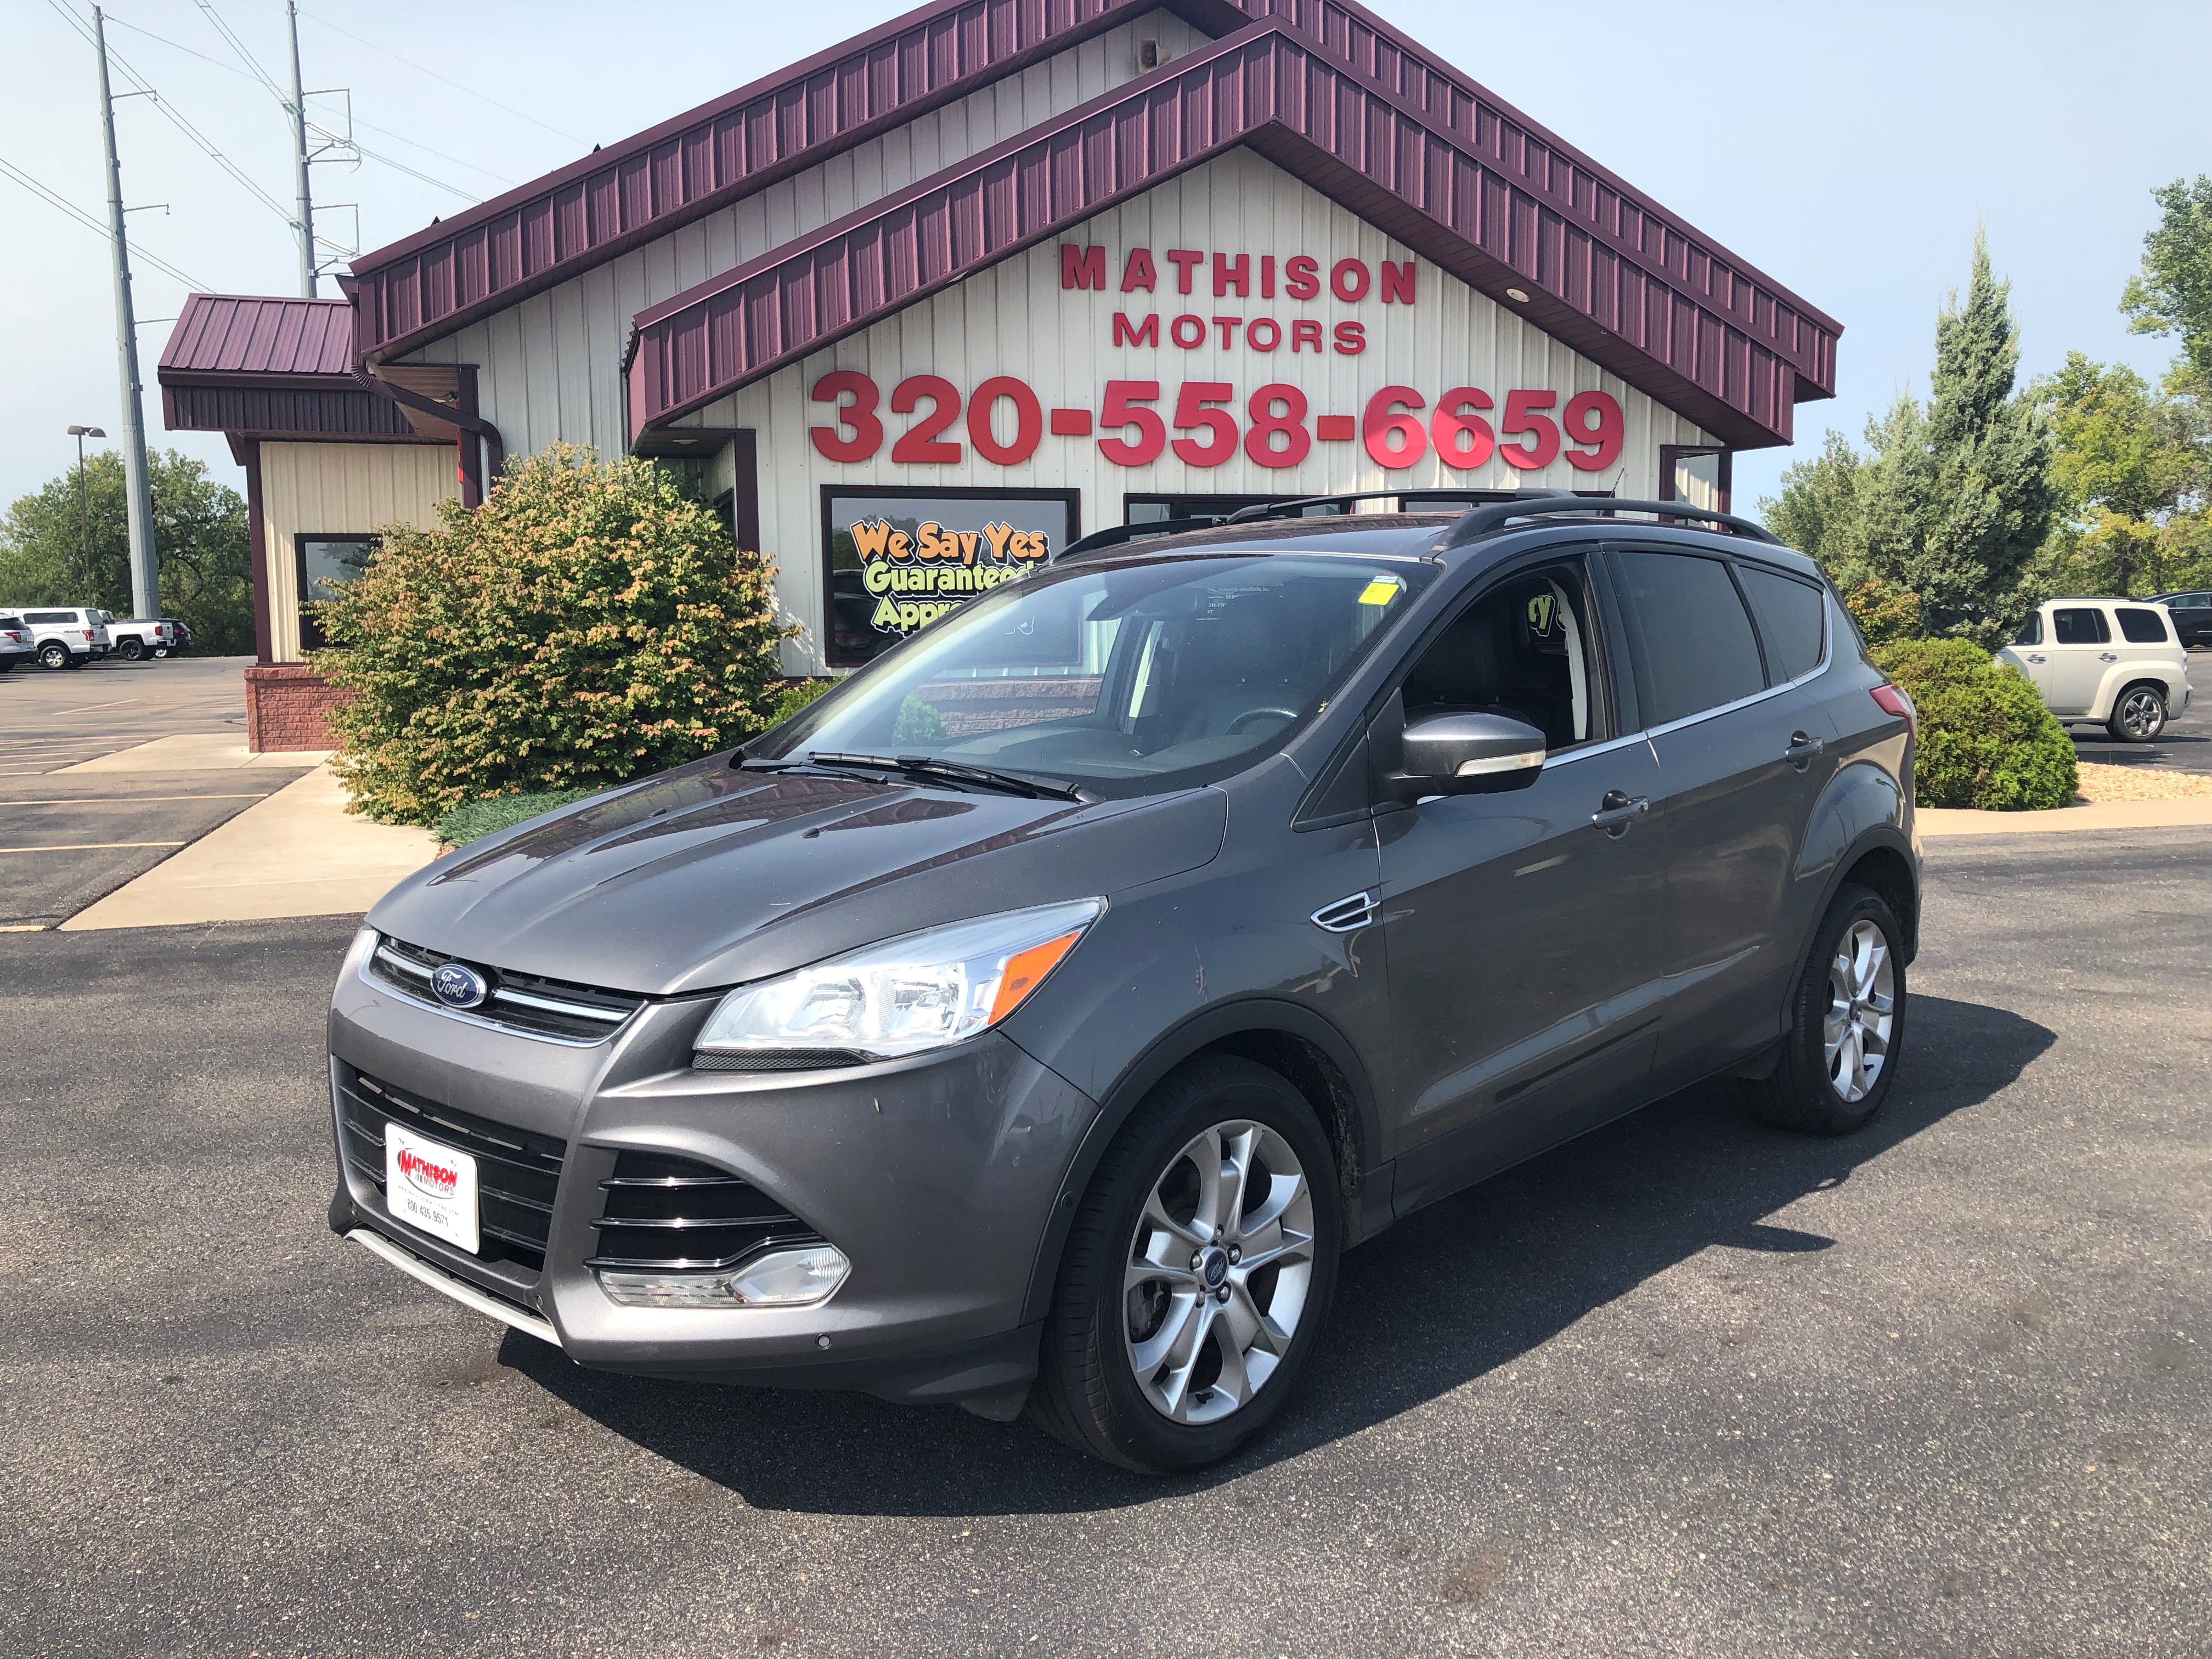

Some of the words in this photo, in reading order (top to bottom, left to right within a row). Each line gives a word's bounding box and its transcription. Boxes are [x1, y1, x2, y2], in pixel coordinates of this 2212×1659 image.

[1061, 244, 1415, 304] MATHISON
[1113, 312, 1366, 354] MOTORS
[810, 370, 1624, 472] 320-558-6659
[851, 519, 911, 561] We
[918, 522, 979, 565] Say
[983, 522, 1047, 559] Yes
[437, 970, 468, 998] Ford
[400, 1149, 458, 1188] MATHISON
[424, 1176, 454, 1196] MOTORS
